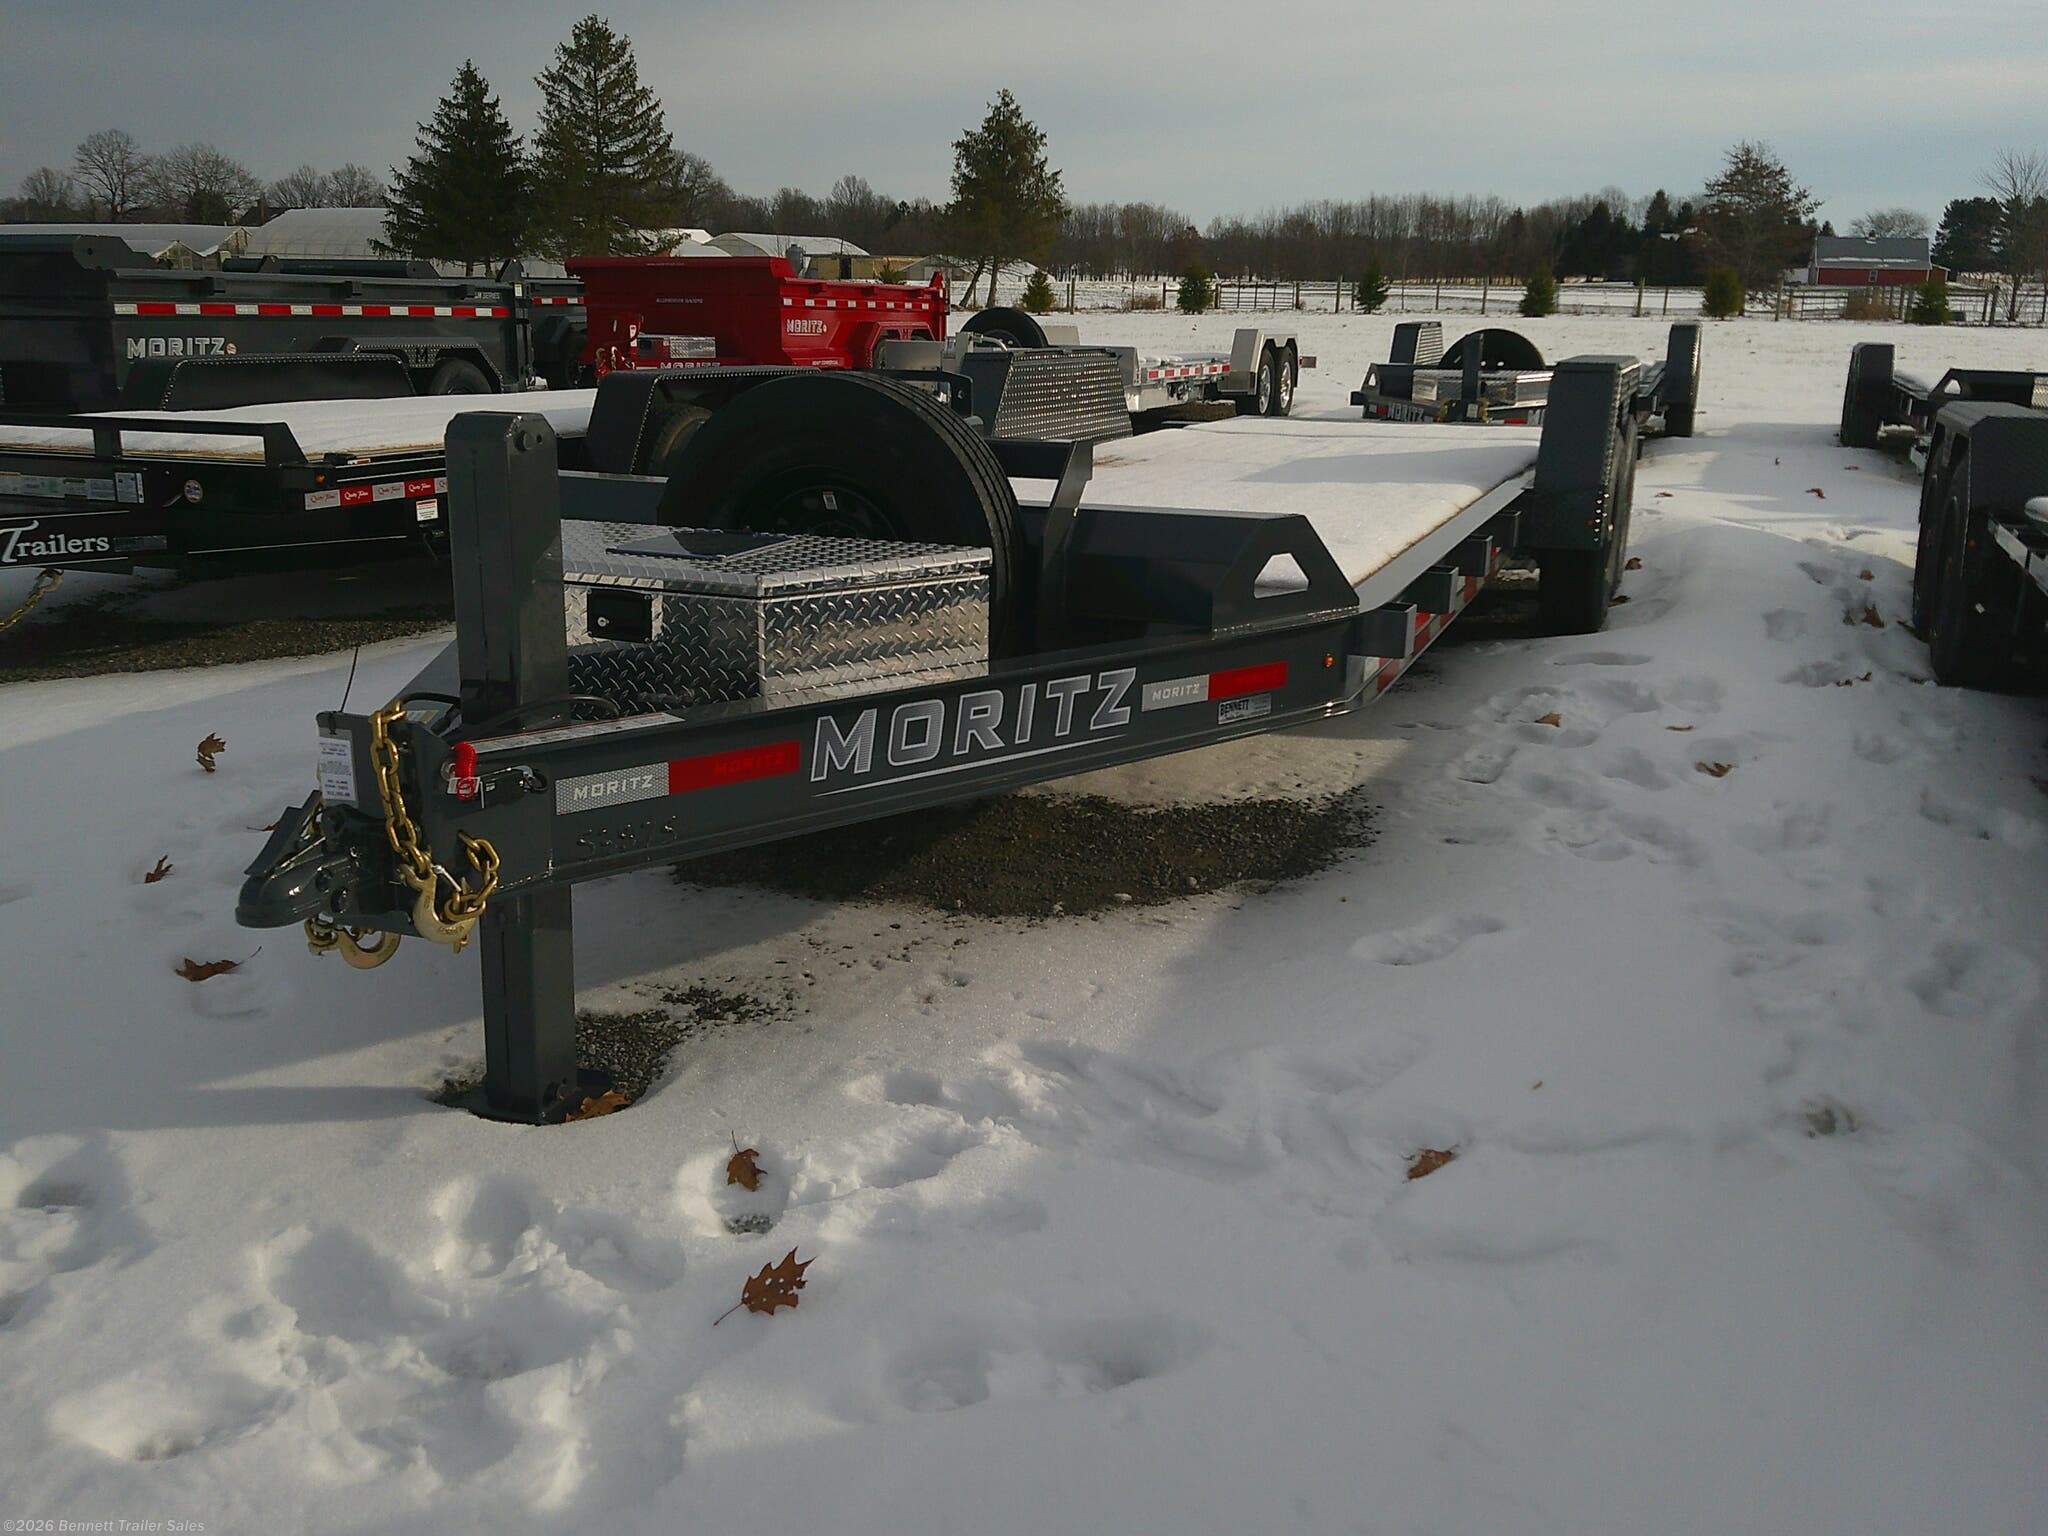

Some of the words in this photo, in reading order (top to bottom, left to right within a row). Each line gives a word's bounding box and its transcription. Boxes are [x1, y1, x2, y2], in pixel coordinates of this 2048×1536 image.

[786, 318, 823, 334] MORITZ
[127, 337, 225, 359] MORITZ
[0, 520, 110, 563] Trailers
[1152, 683, 1200, 702] MORITZ
[1219, 699, 1250, 716] BENNETT
[811, 667, 1137, 783] MORITZ
[572, 774, 653, 801] MORITZ
